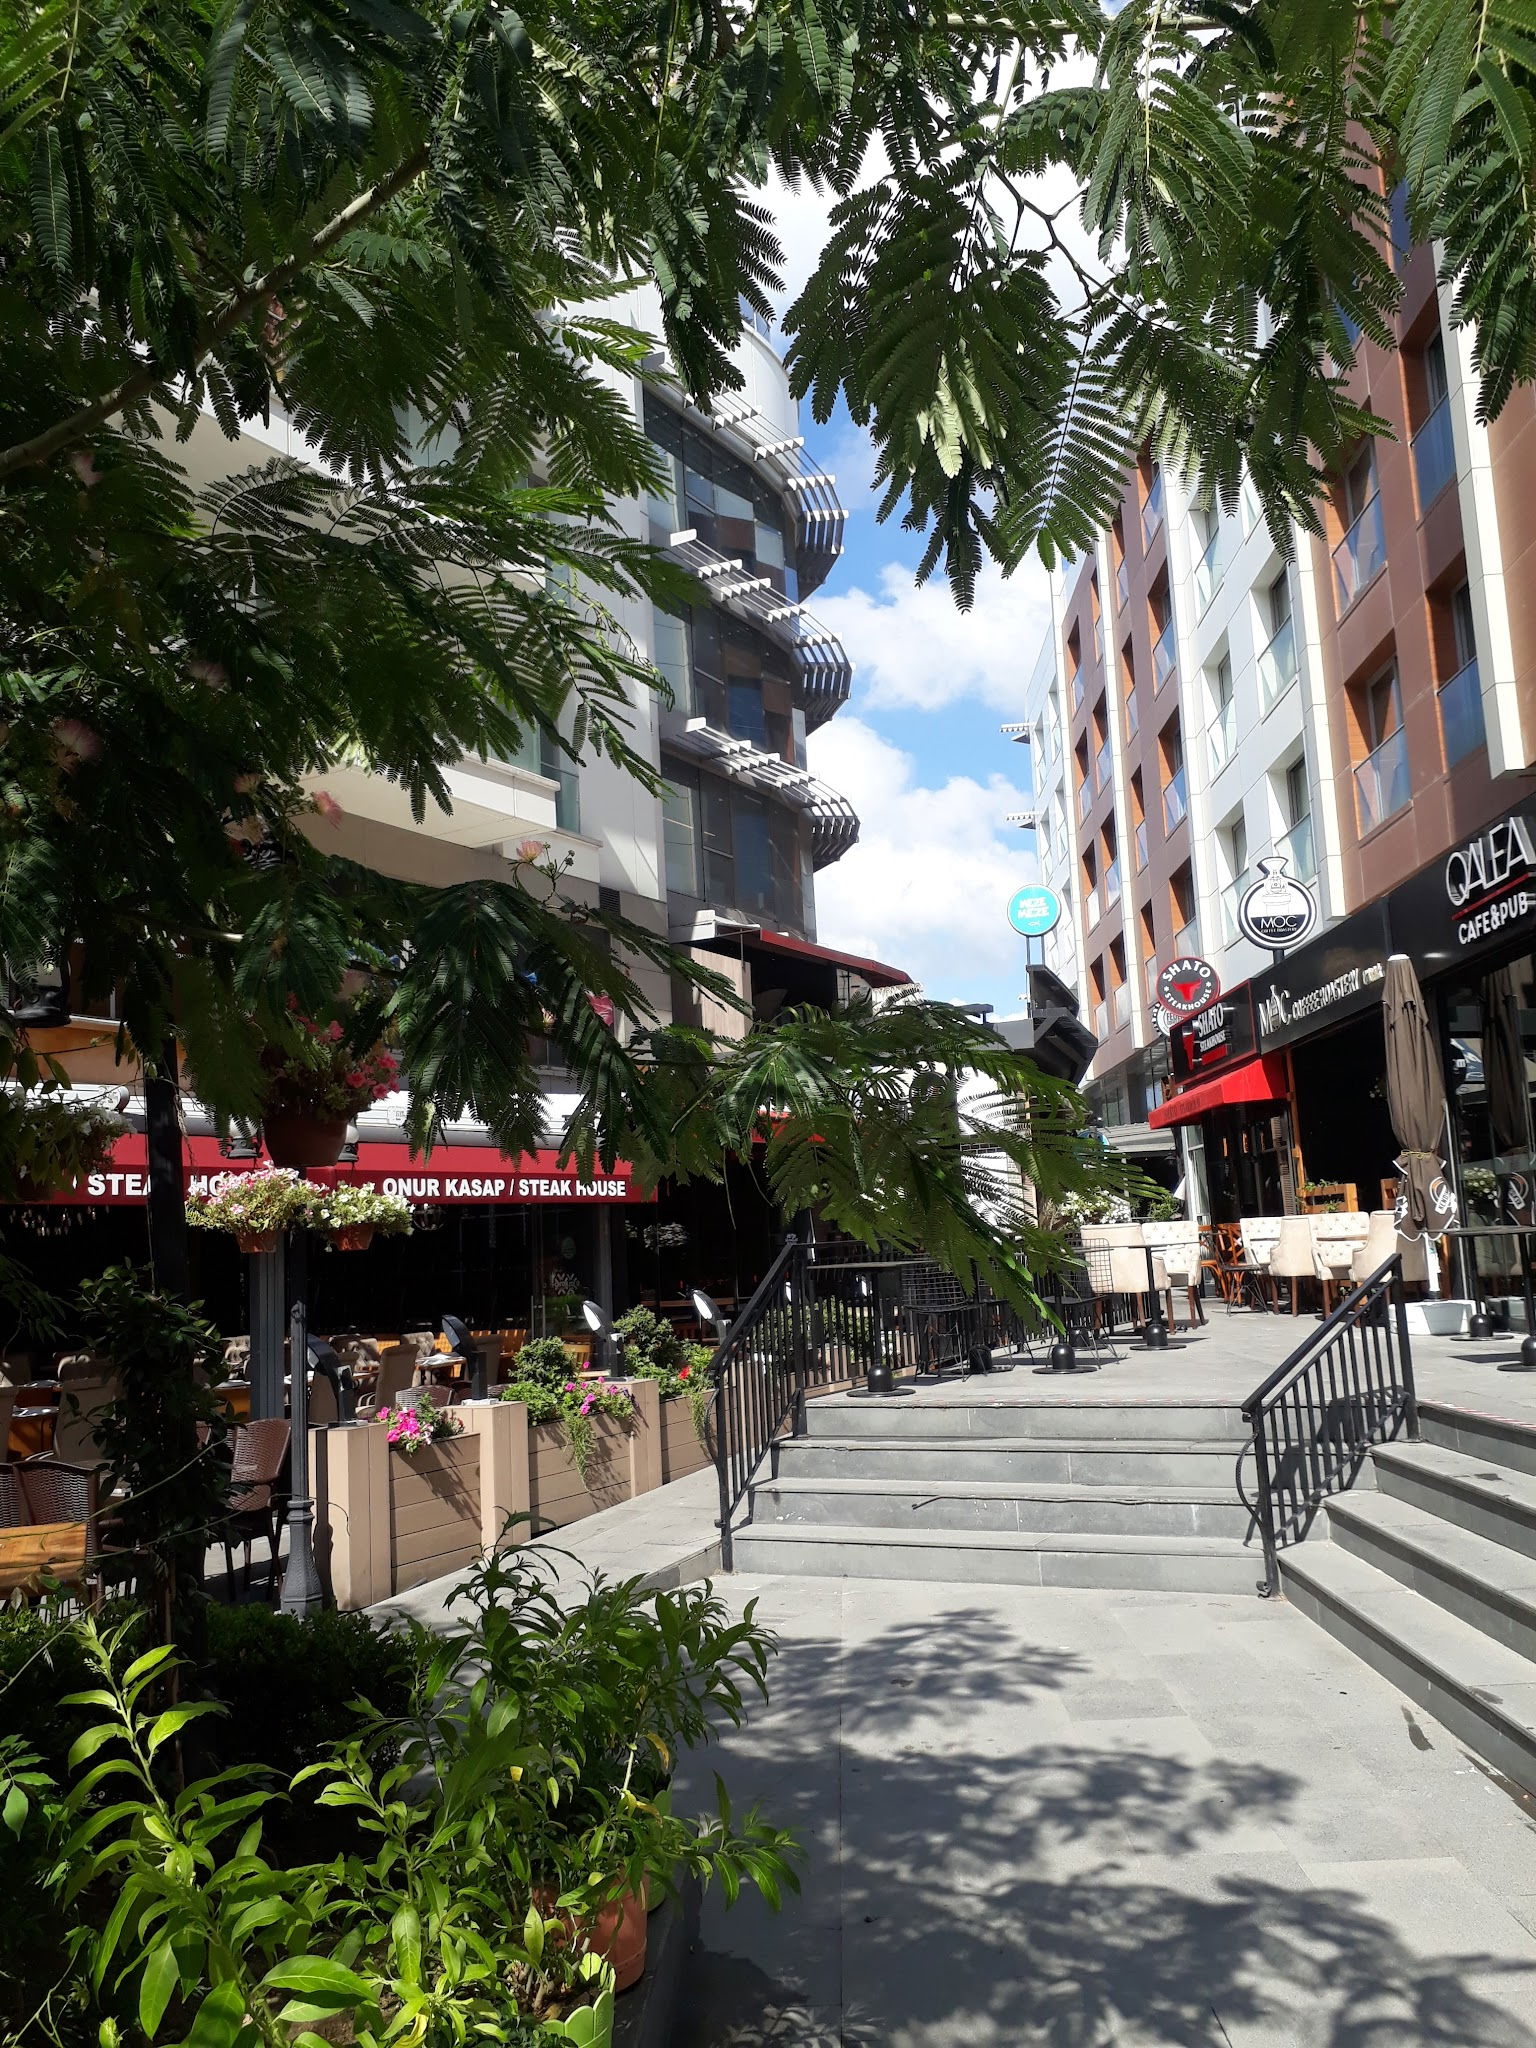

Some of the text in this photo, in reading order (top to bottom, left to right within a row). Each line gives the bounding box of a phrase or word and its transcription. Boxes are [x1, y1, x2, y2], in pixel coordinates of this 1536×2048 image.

[1260, 915, 1298, 929] MOC
[1458, 891, 1528, 945] CAFE&PUB
[1162, 959, 1211, 982] SHATO
[1164, 989, 1212, 1010] STEAKHOUSE
[1197, 1002, 1224, 1038] SHATO
[382, 1178, 441, 1197] ONUR
[445, 1179, 505, 1197] KASAP
[518, 1179, 572, 1197] STEAK
[576, 1180, 626, 1197] HOUSE
